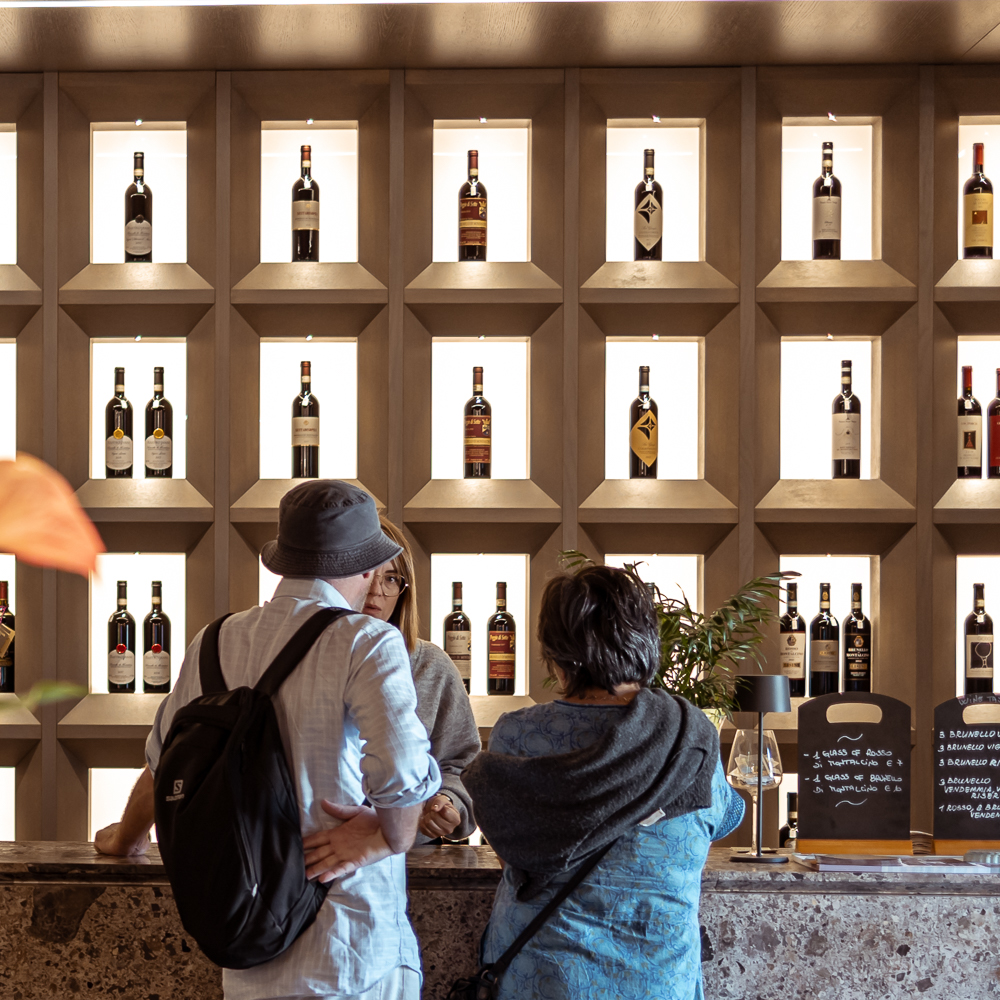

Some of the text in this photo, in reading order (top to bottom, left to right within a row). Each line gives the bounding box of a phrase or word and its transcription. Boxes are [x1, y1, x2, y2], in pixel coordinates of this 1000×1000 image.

[946, 743, 985, 751] BRUNELLO
[822, 748, 848, 758] GLASS
[947, 758, 988, 767] BRUNELLO
[824, 773, 850, 782] GLASS
[947, 777, 991, 785] BRUNELLO
